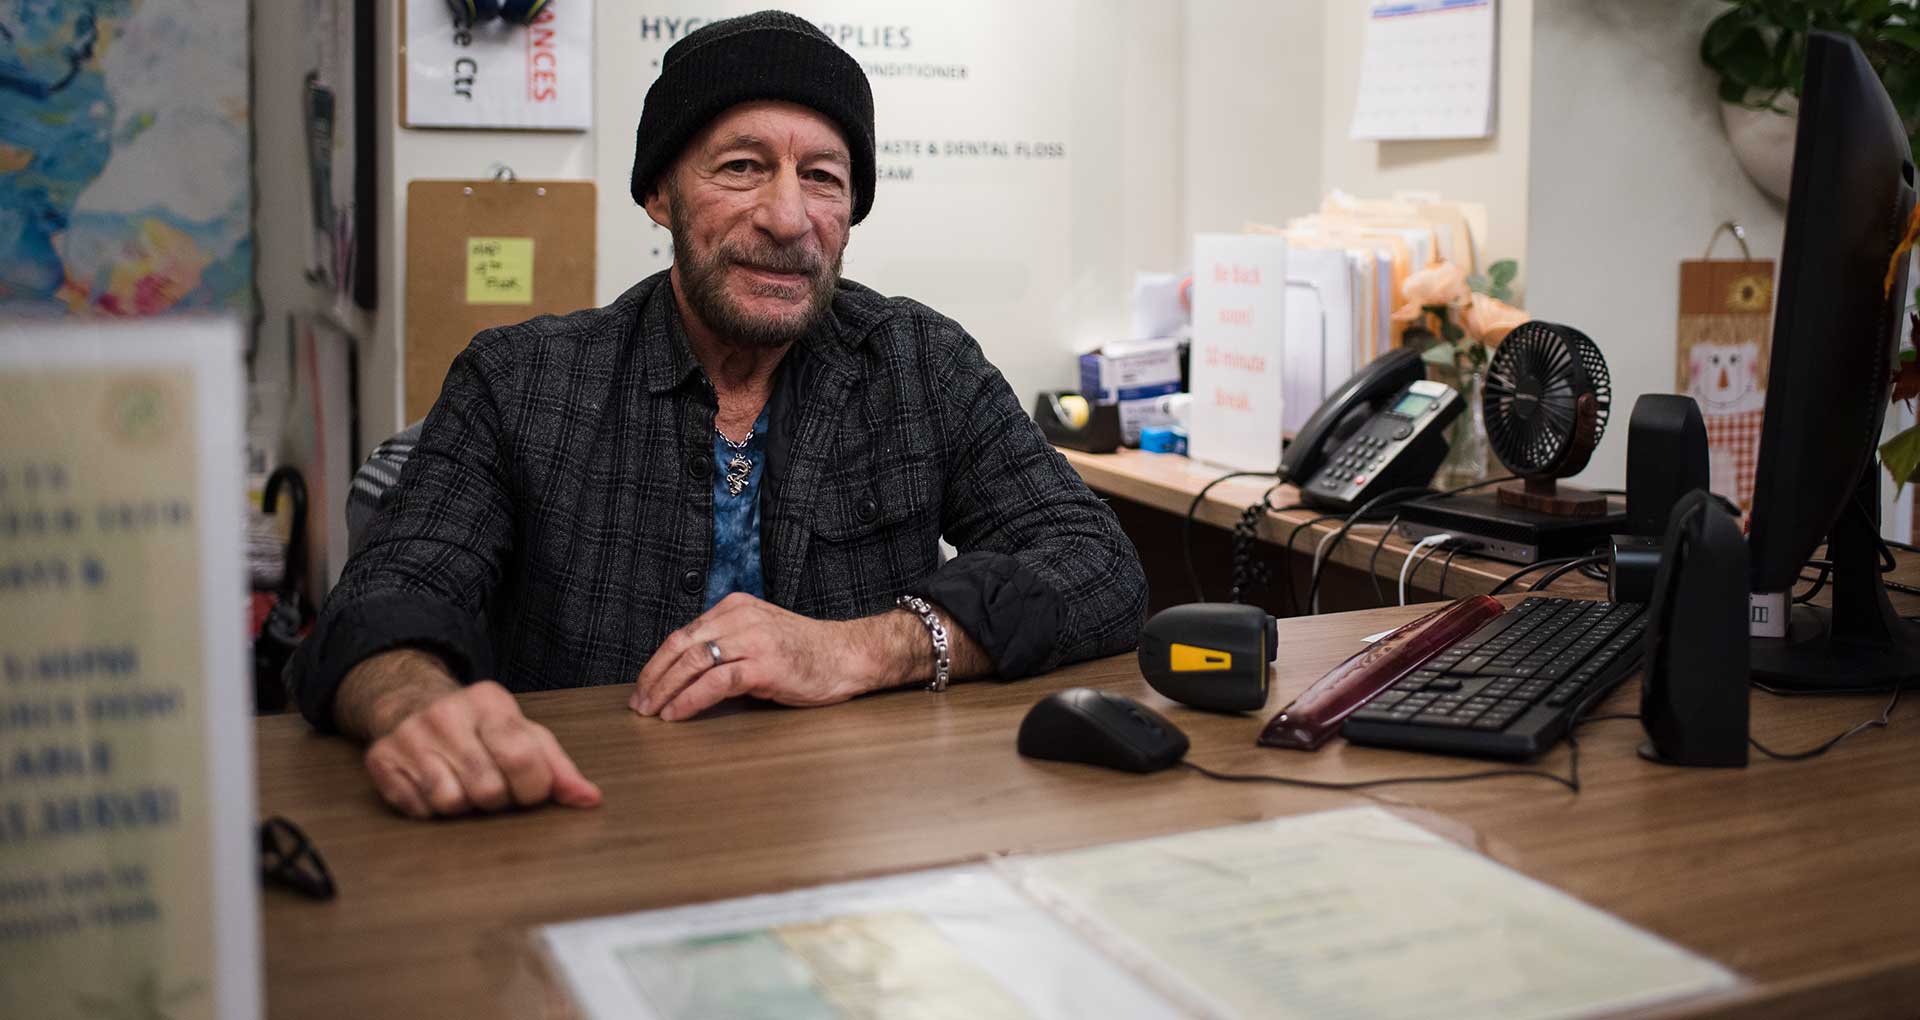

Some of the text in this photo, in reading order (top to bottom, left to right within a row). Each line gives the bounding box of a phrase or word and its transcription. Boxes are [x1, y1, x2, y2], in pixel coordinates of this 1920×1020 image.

[641, 16, 912, 48] HYG PPLIES
[452, 21, 477, 100] ce Ctr
[533, 8, 557, 103] ANCES
[862, 62, 969, 79] ONDITIONER
[876, 141, 1066, 157] ASTE & DENTAL FLOSS
[877, 165, 913, 179] EAM
